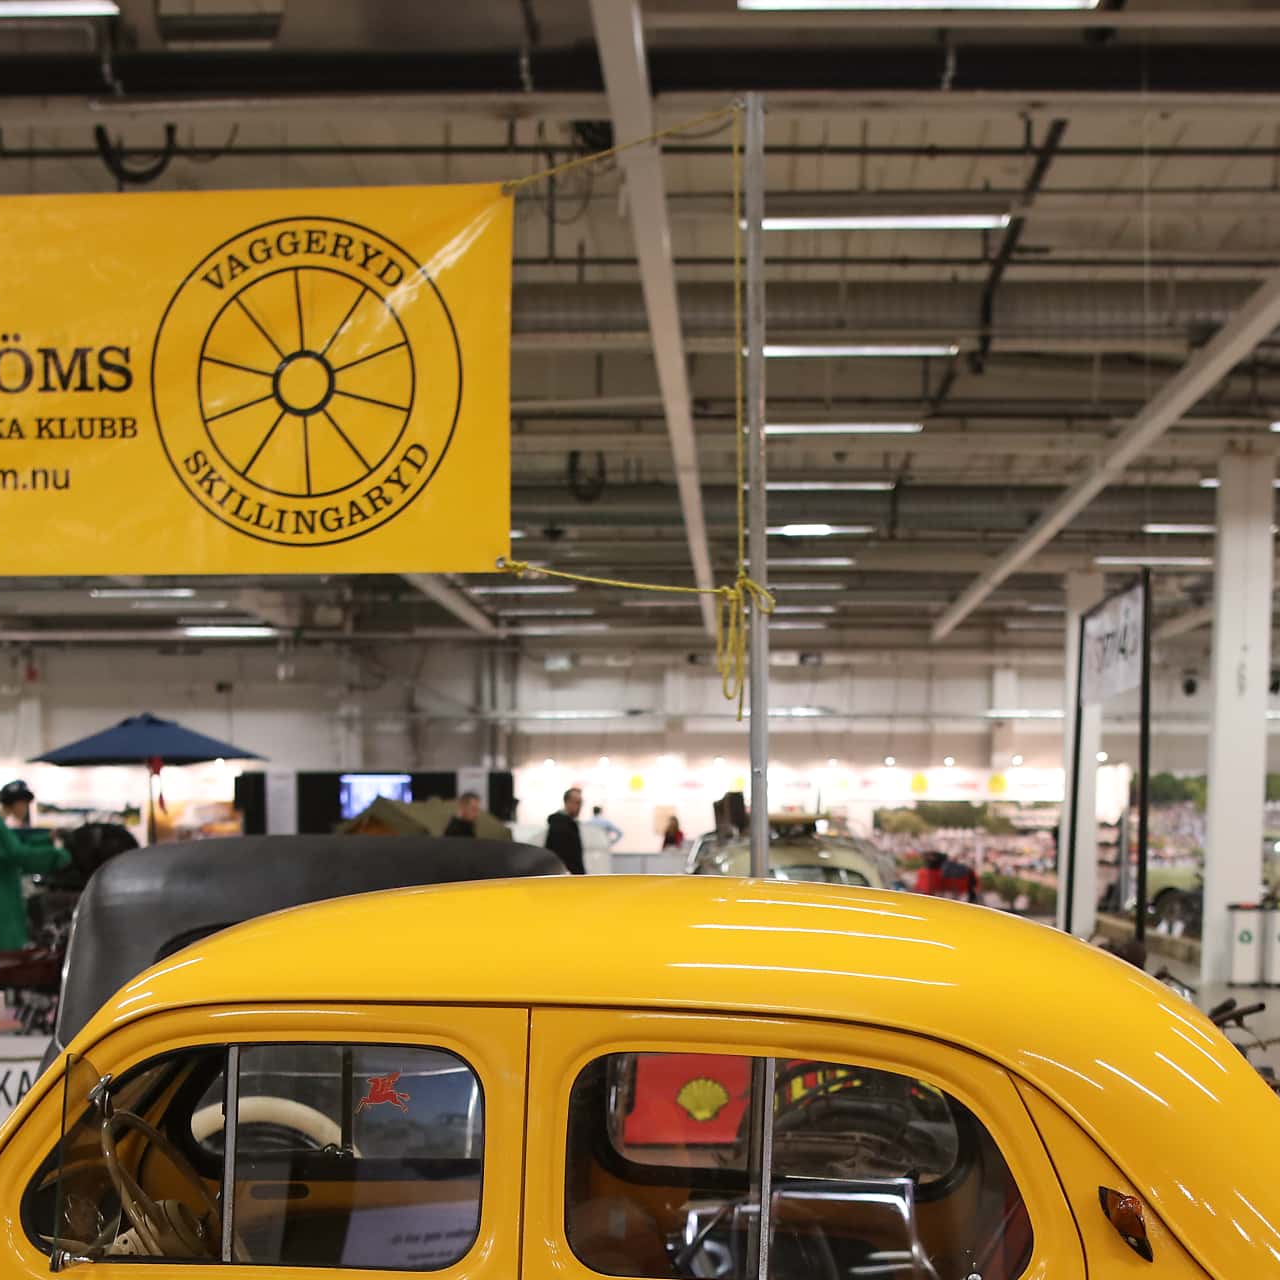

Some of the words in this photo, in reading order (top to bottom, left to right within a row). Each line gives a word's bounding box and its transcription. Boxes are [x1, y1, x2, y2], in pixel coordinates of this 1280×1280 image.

[201, 229, 406, 292] VAGGERYD
[35, 416, 138, 440] KLUBB
[183, 442, 430, 536] SKILLINGARYD
